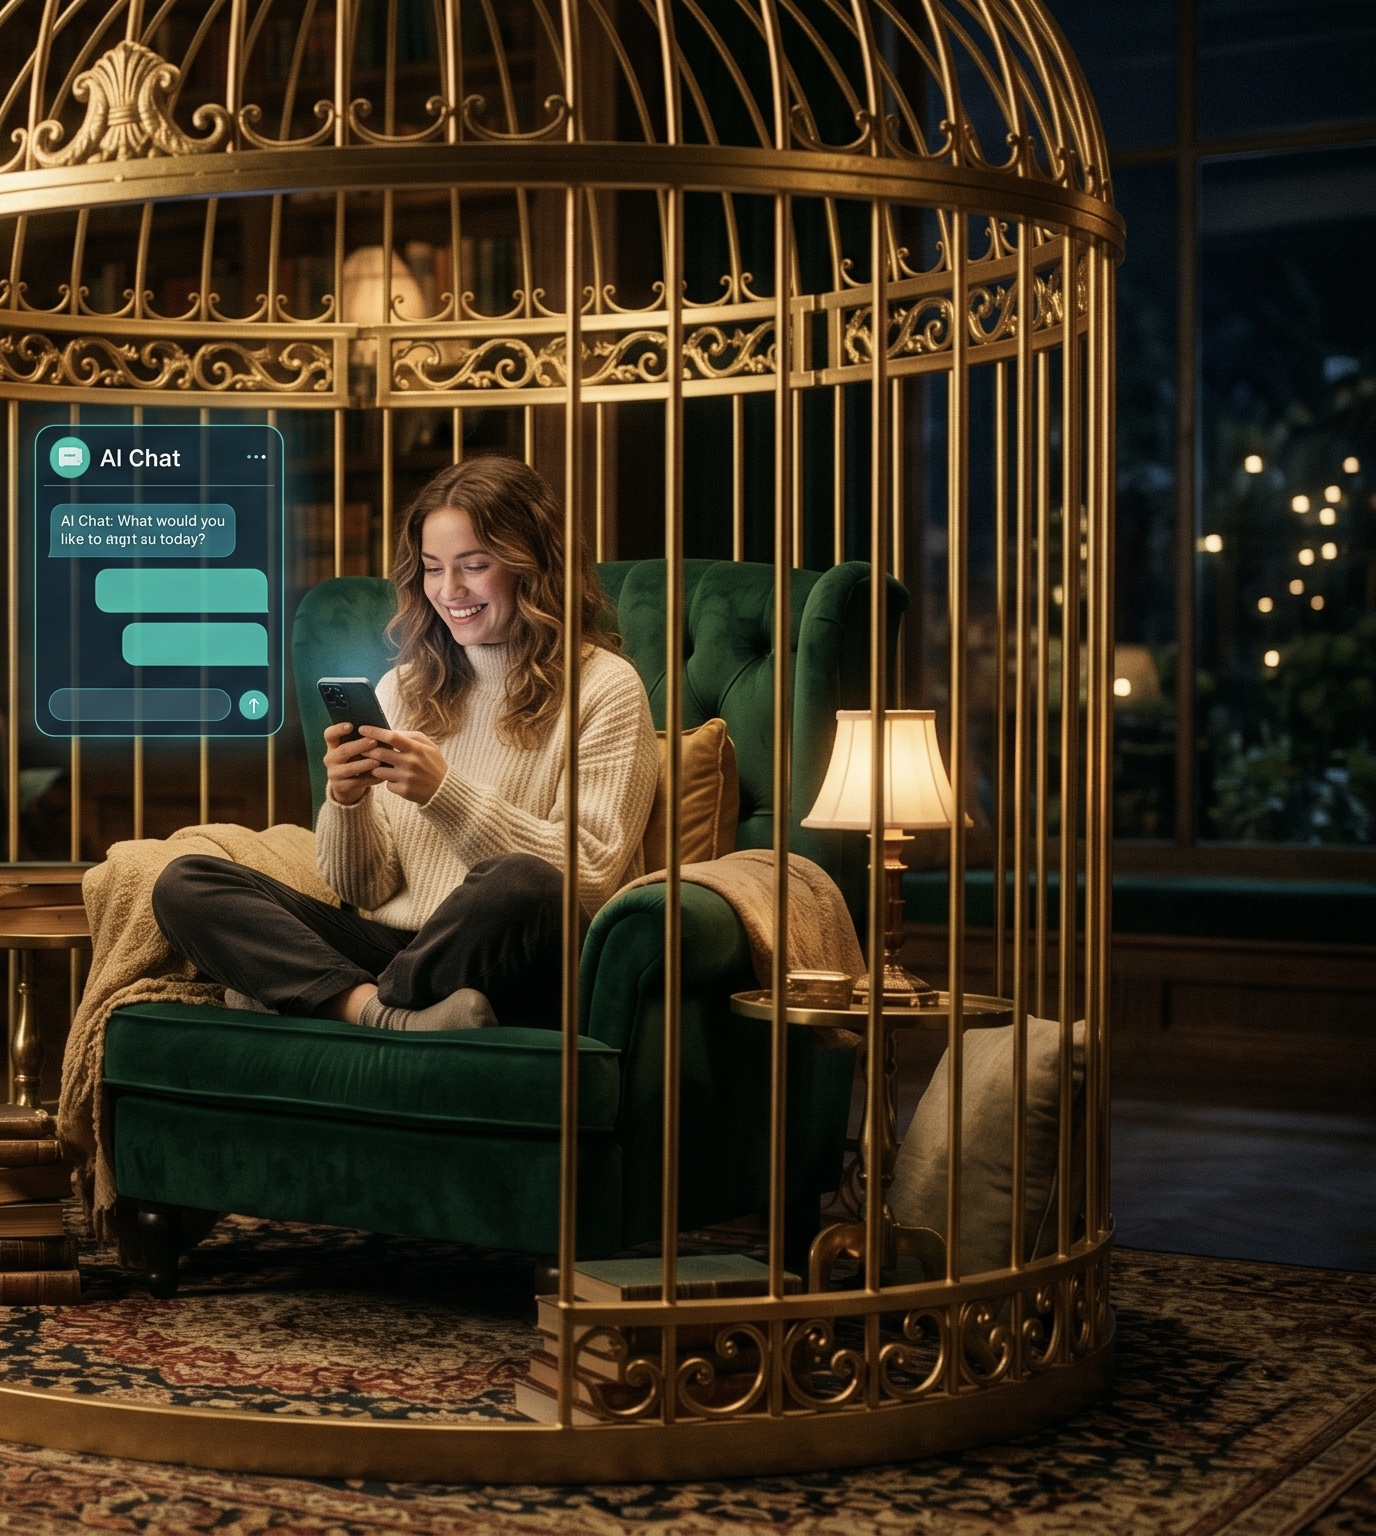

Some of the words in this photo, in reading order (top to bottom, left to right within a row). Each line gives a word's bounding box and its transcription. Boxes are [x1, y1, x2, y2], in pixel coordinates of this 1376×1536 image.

[99, 448, 122, 467] AI
[129, 448, 181, 467] Chat
[60, 514, 74, 527] AI
[78, 514, 114, 527] Chat:
[117, 514, 153, 527] What
[156, 514, 197, 527] would
[200, 517, 225, 531] you
[61, 532, 85, 545] like
[88, 533, 102, 545] to
[159, 532, 206, 548] today?
